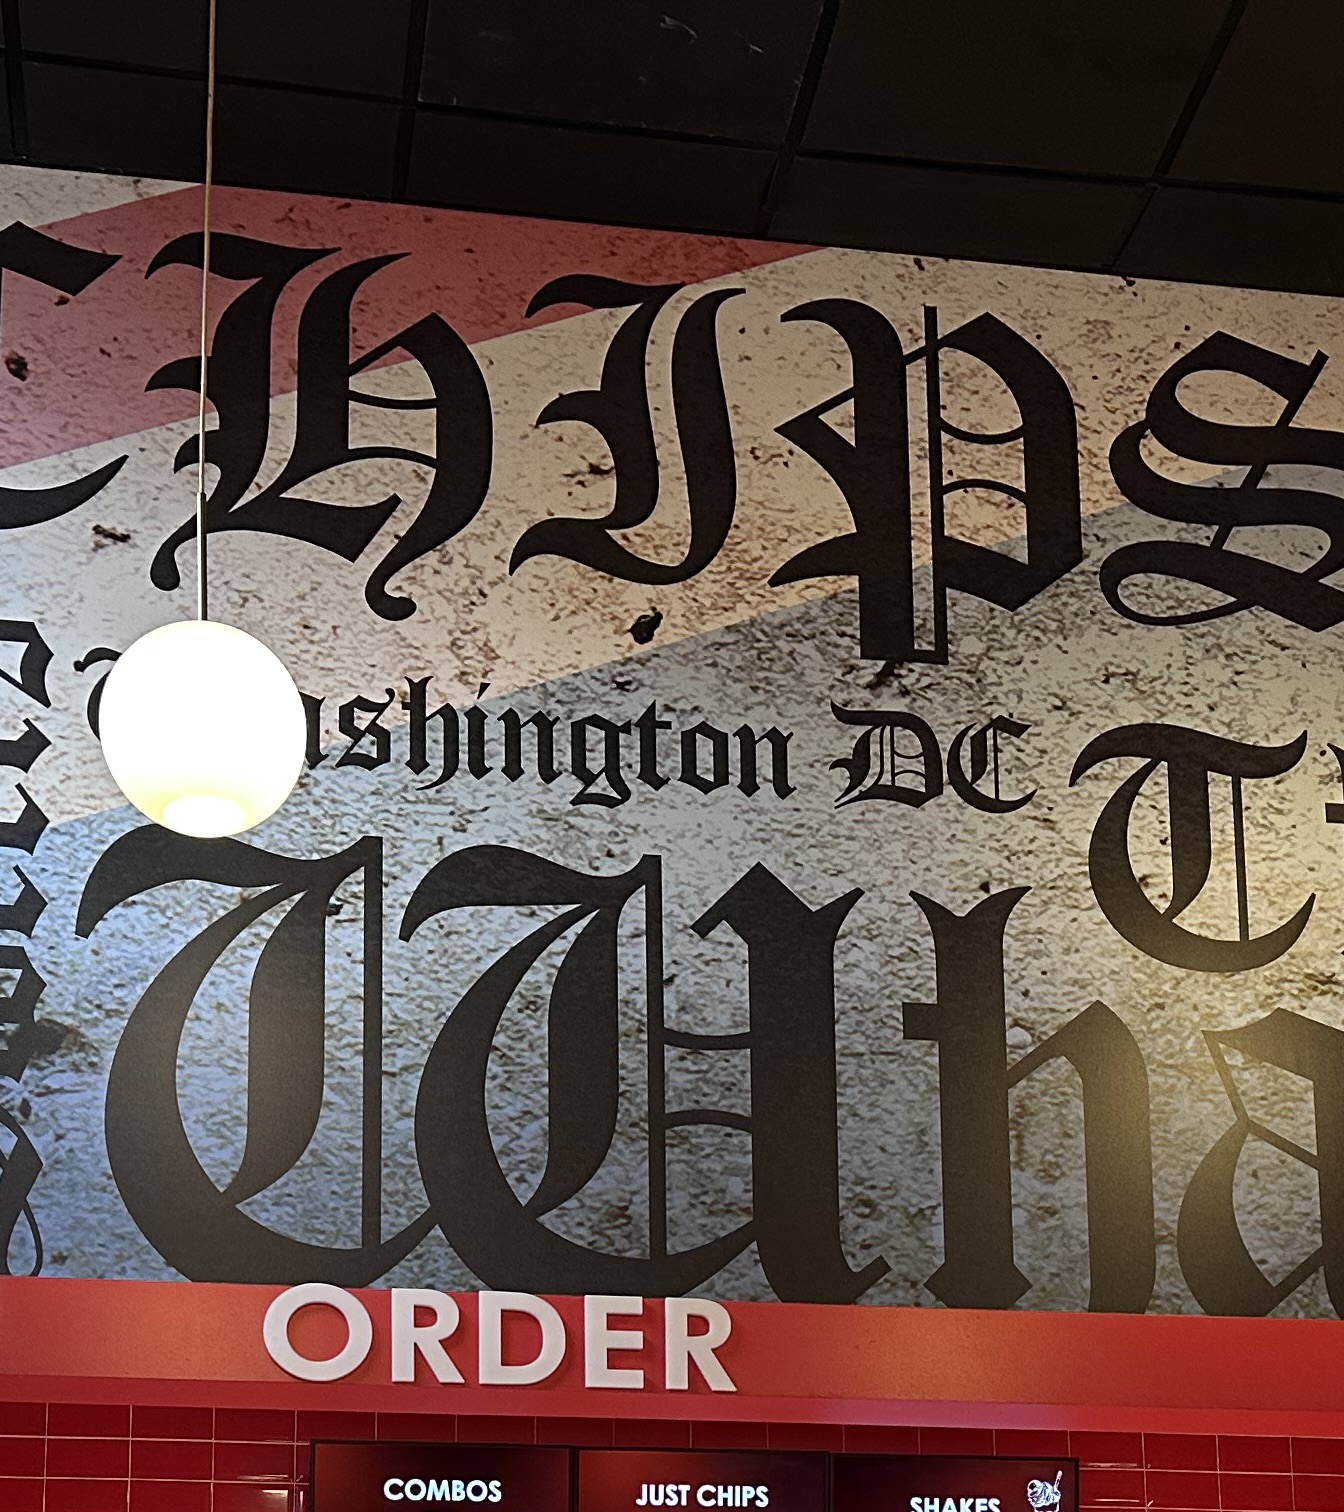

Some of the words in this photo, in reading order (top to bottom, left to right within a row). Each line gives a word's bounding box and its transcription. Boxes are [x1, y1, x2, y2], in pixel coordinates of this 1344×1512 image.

[828, 700, 1038, 814] DC
[261, 1282, 738, 1393] ORDER
[384, 1478, 501, 1502] COMBOS
[636, 1484, 690, 1506] JUST
[697, 1485, 768, 1507] CHIPS
